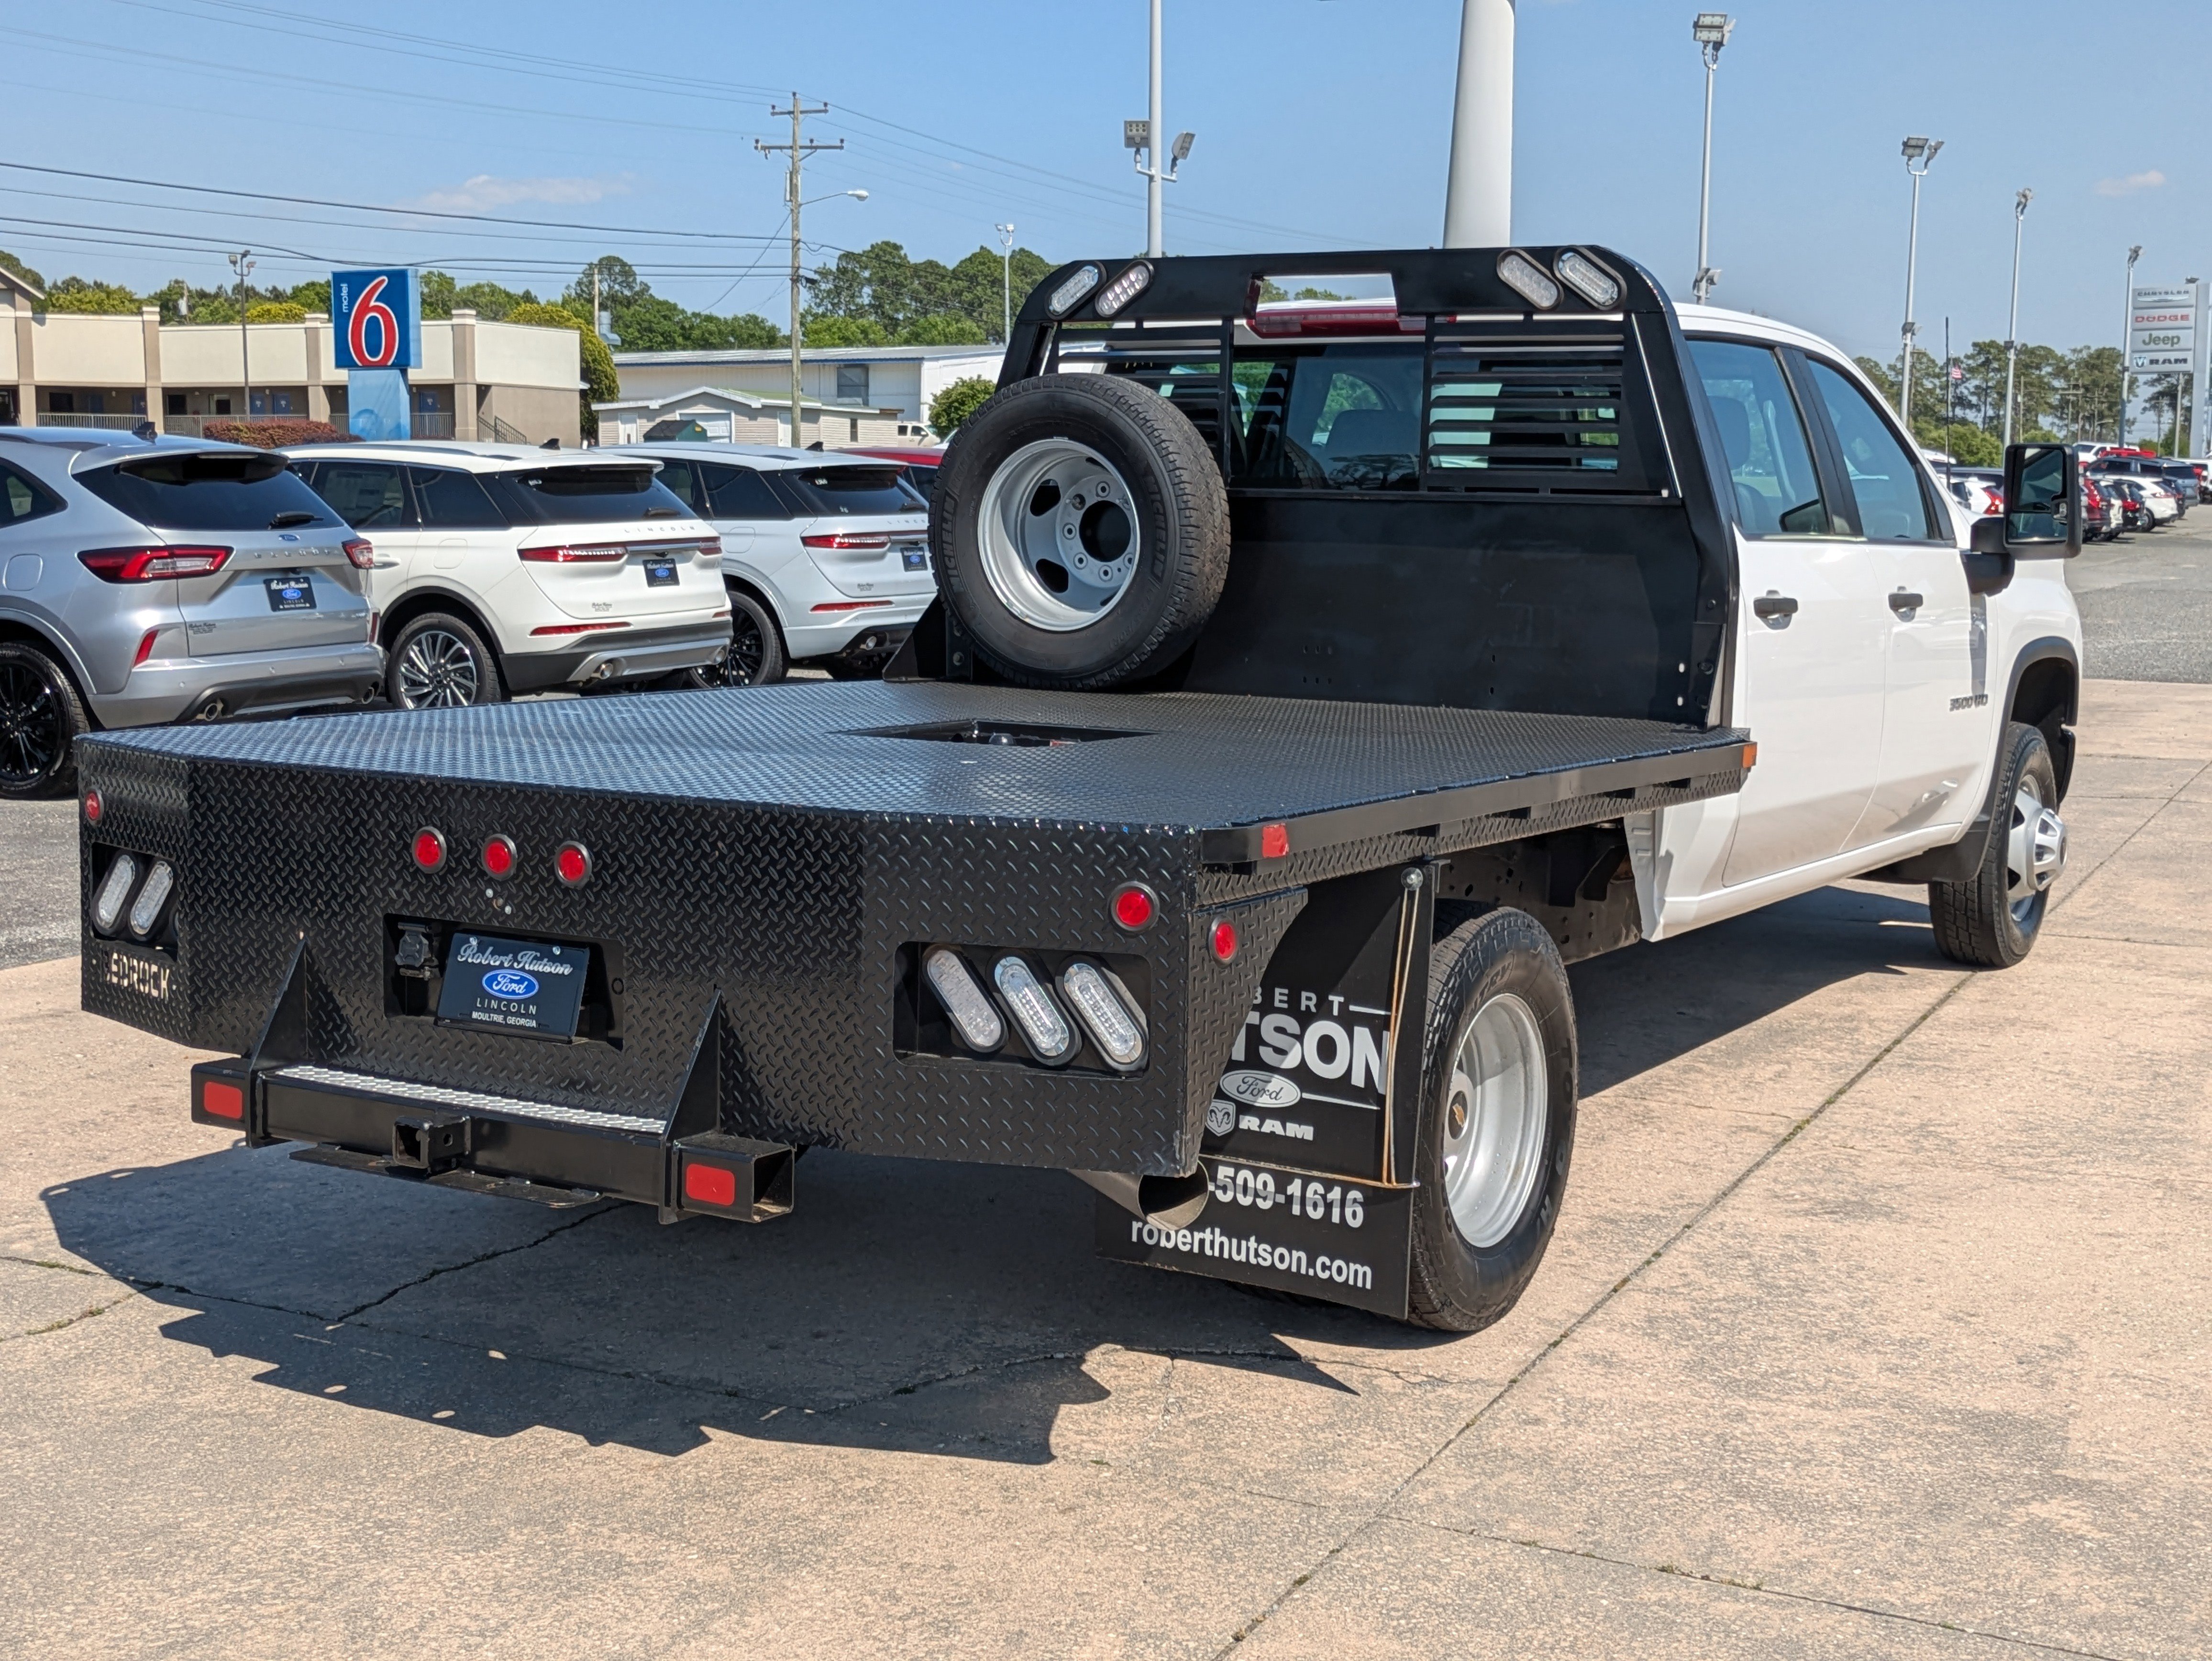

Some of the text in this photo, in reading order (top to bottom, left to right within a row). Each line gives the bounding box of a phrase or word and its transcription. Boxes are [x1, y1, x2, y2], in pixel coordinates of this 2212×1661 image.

[340, 284, 348, 312] motel
[348, 276, 399, 366] 6
[2135, 314, 2189, 322] DODGE
[2142, 333, 2180, 347] Jeep
[1148, 476, 1166, 579] MICHELIN
[941, 494, 963, 593] MICHELIN
[1949, 694, 1988, 712] 3500 HD
[457, 942, 573, 975] Robert Hutson
[492, 973, 527, 994] Ford
[476, 997, 537, 1015] LINCOLN
[472, 1011, 537, 1028] MOULTRIE, GEORGIA
[1236, 1075, 1283, 1102] Ford
[1239, 1115, 1314, 1141] RAM
[1131, 1220, 1372, 1290] roberthutson.com
